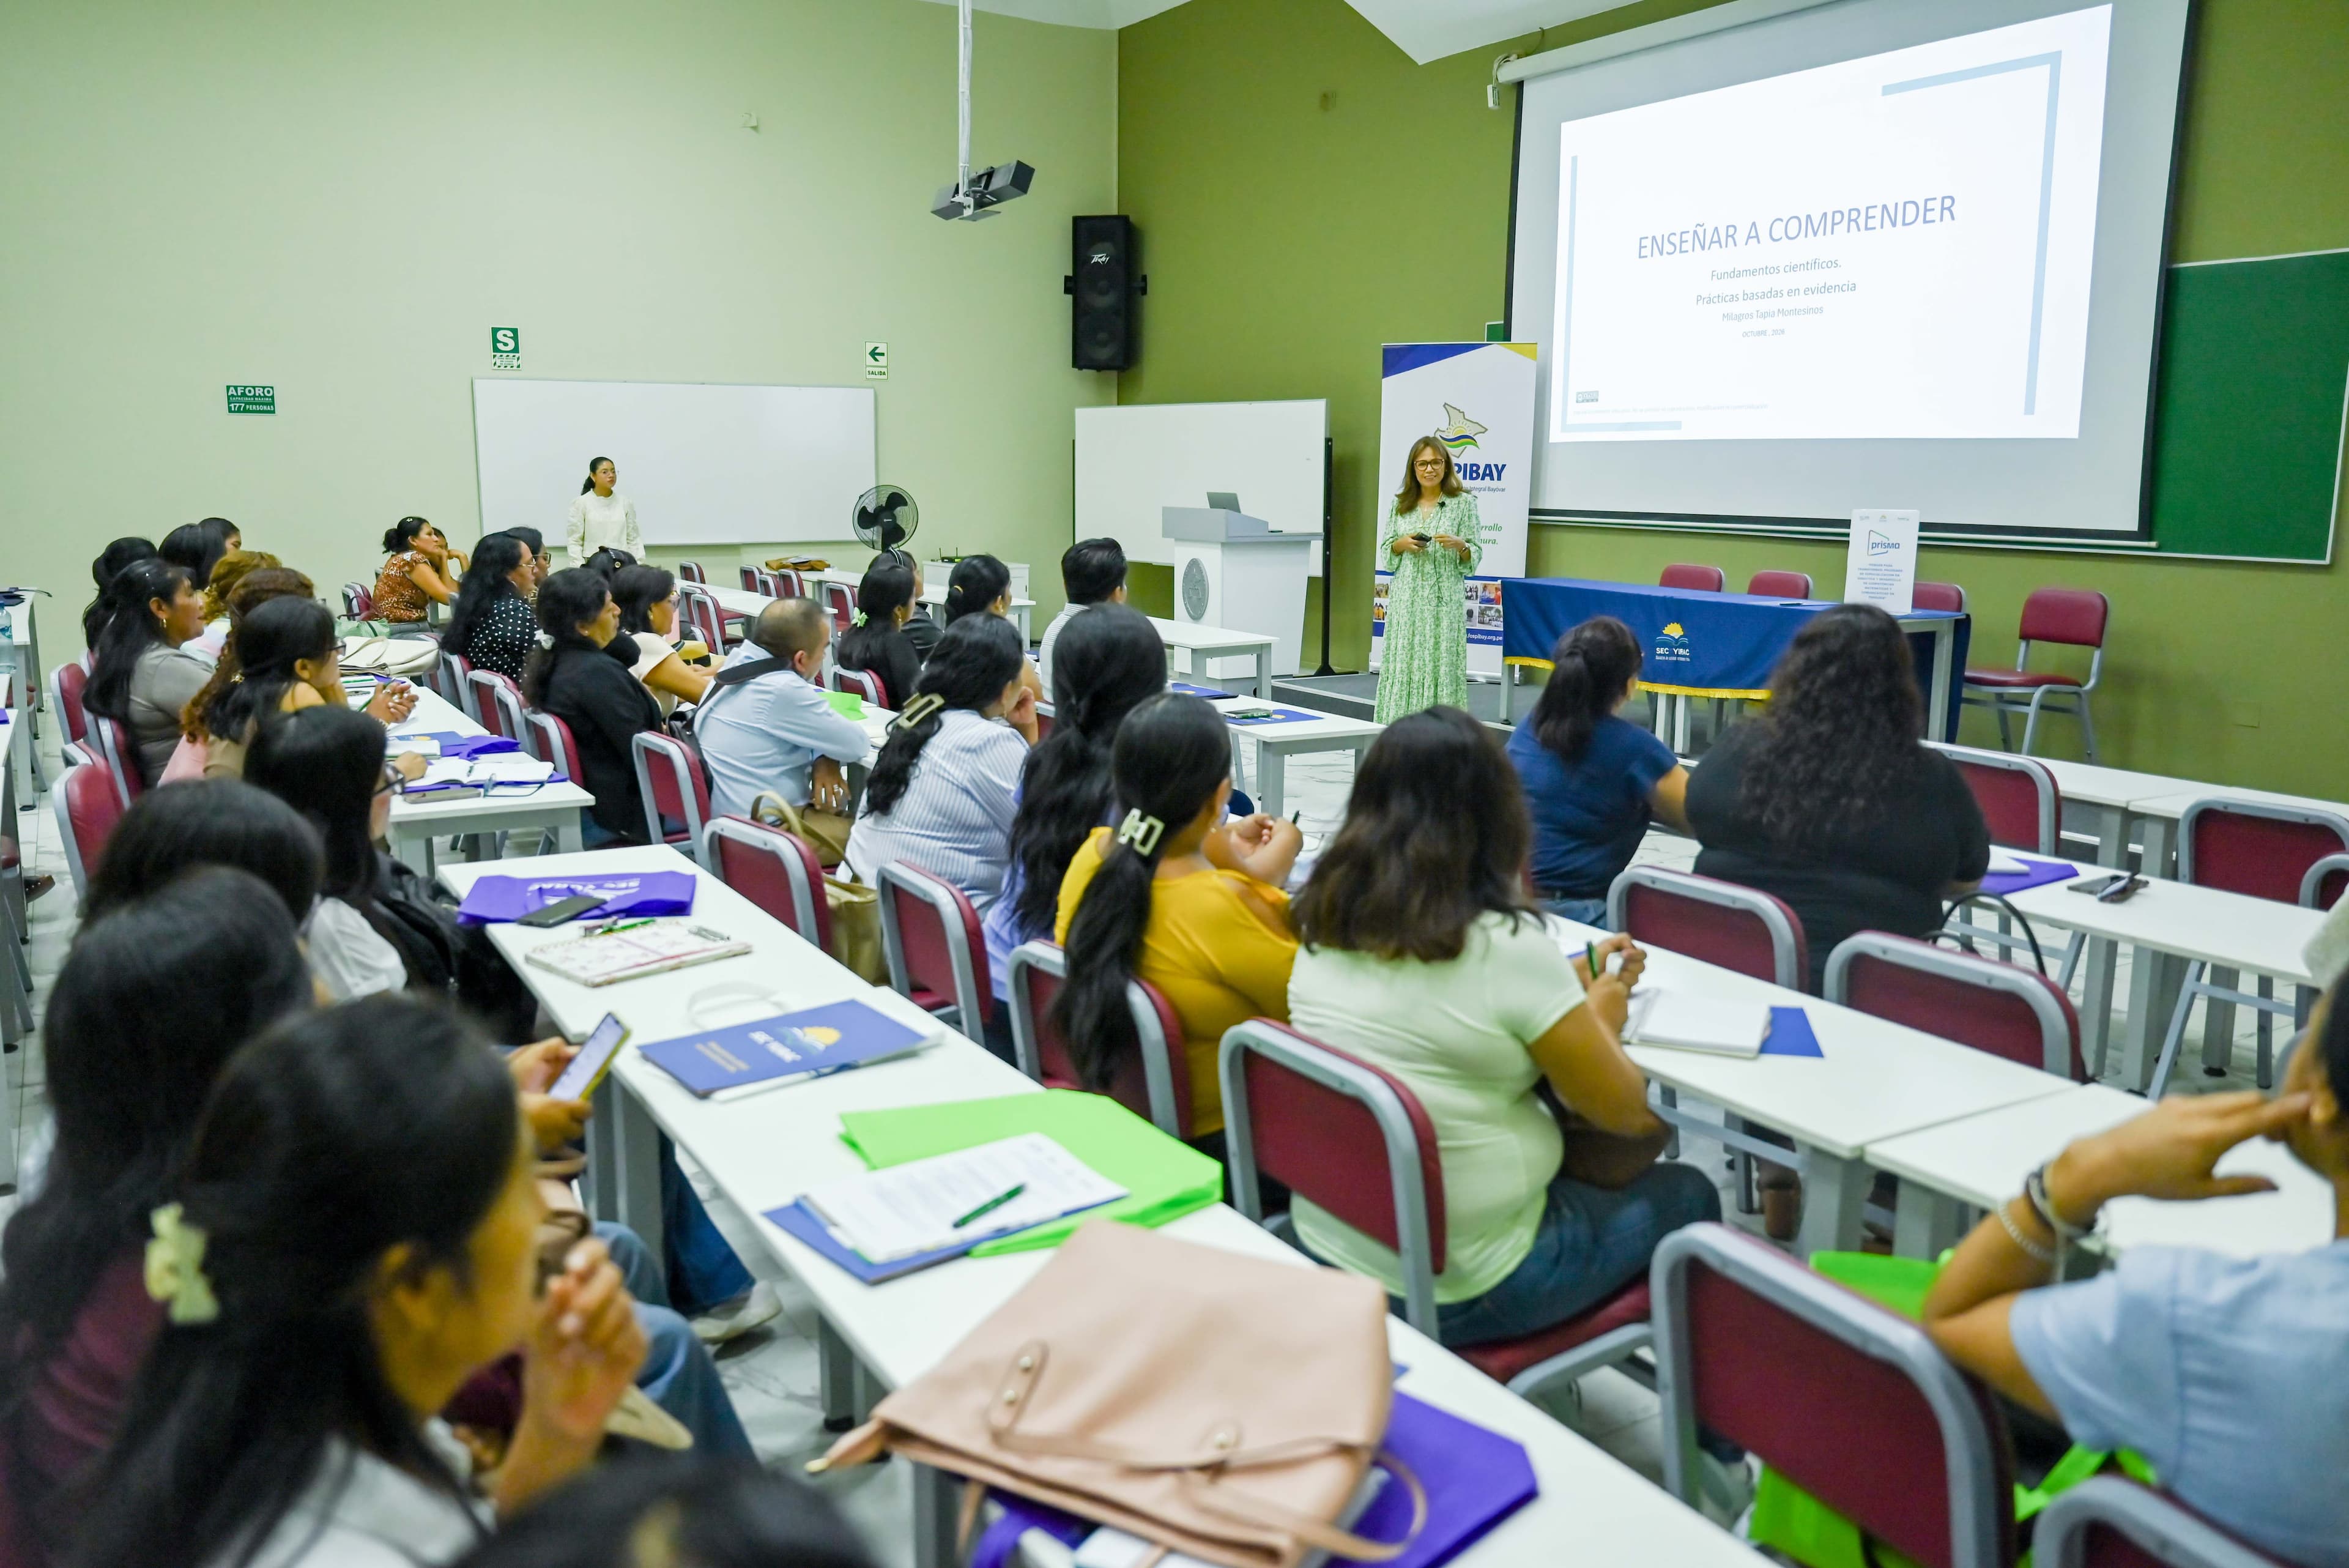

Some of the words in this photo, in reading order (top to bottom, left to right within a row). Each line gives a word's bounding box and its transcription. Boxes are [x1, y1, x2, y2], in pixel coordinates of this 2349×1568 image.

[1638, 223, 1737, 259] ENSEÑAR
[1745, 221, 1761, 245] A
[1768, 195, 1956, 242] COMPRENDER
[1711, 266, 1781, 281] Fundamentos
[1783, 258, 1841, 274] científicos.
[1696, 292, 1740, 305] Prácticas
[1742, 287, 1784, 301] basadas
[1787, 288, 1800, 297] en
[1803, 280, 1857, 295] evidencia
[1722, 311, 1754, 322] Milagros
[1755, 309, 1776, 321] Tapia
[1777, 305, 1824, 318] Montesinos
[496, 330, 515, 351] S
[228, 386, 273, 396] AFORO
[229, 403, 245, 412] 177
[1871, 541, 1900, 551] prisma
